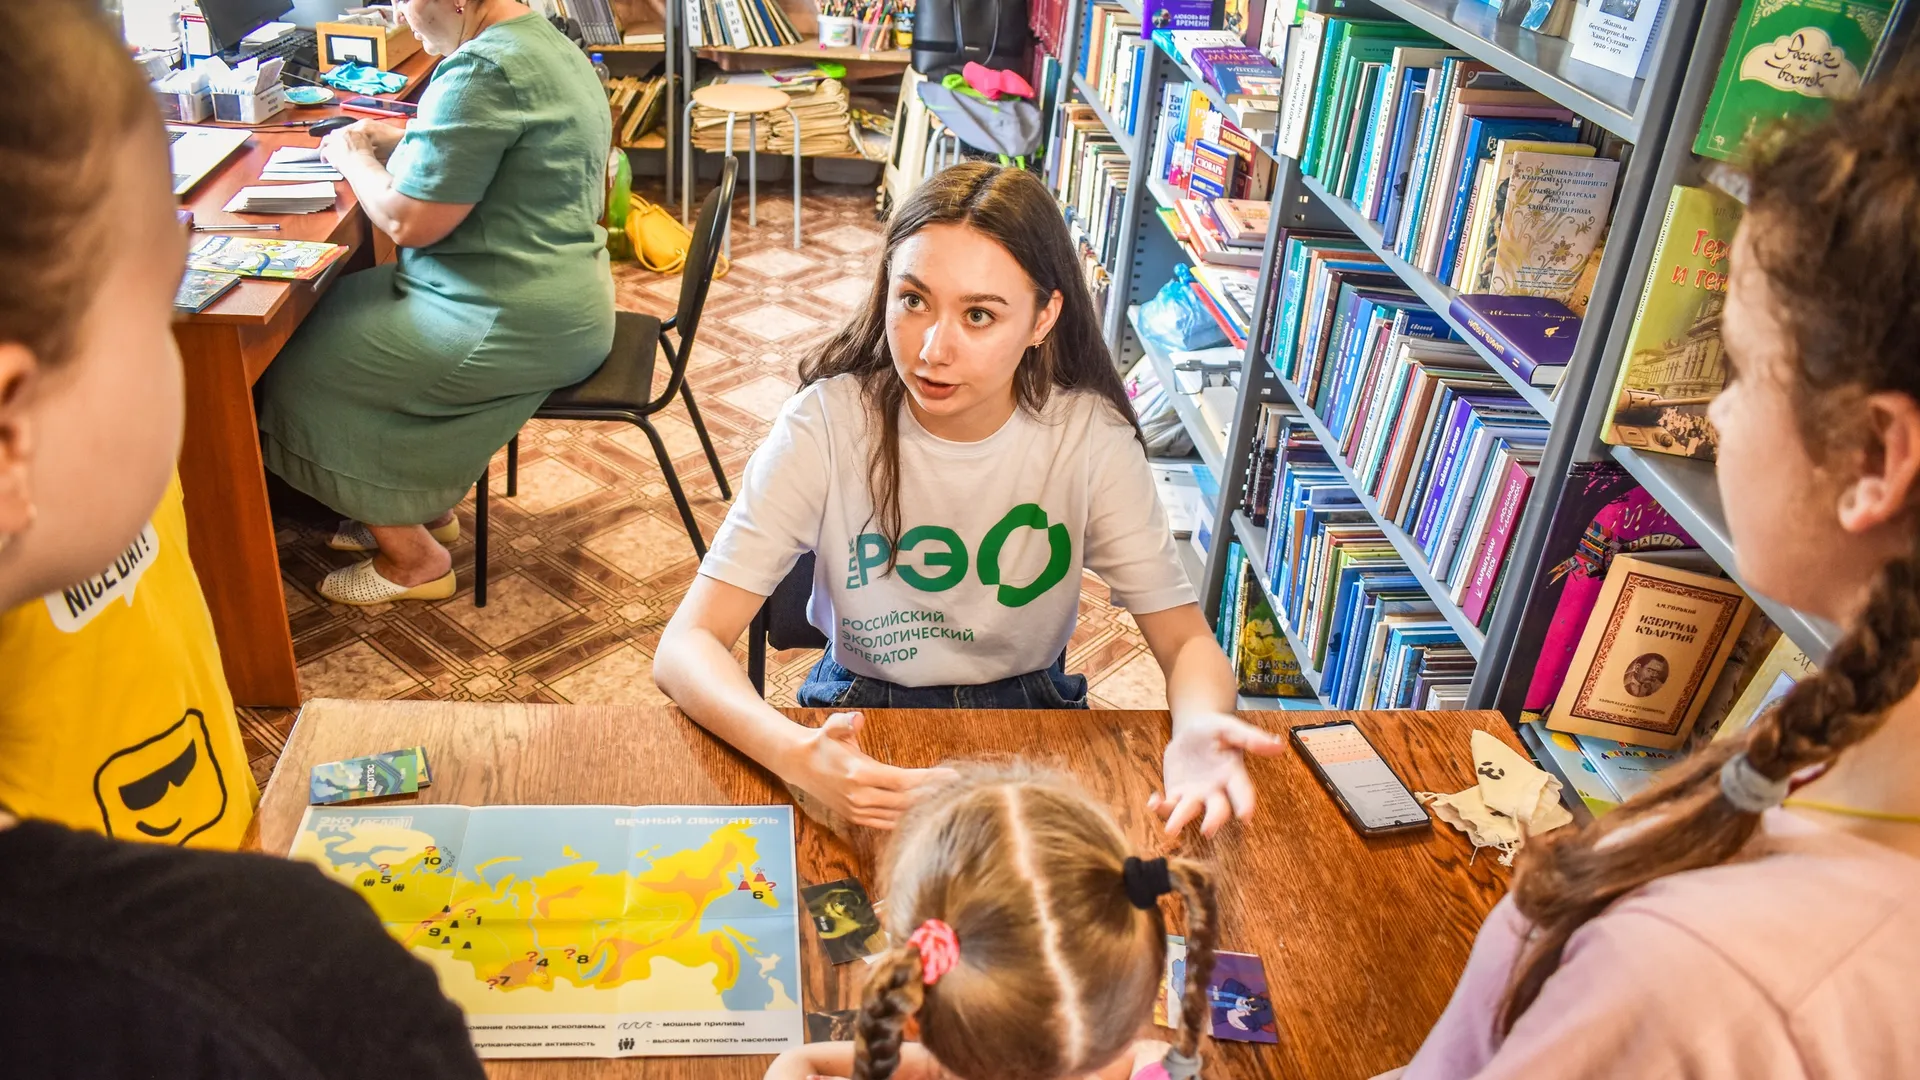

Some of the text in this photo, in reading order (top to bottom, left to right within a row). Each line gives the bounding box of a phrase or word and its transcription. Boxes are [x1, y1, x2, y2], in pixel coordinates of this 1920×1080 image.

[1175, 19, 1209, 27] ВРЕМЕНИ
[1589, 22, 1621, 37] бессмертие
[1603, 19, 1623, 29] Жизнь
[1592, 31, 1628, 48] Хана Султана
[1774, 33, 1840, 68] Россия
[1195, 156, 1223, 175] СЛОВАРЬ
[1528, 189, 1596, 199] КРЫМСКОТАТАРСКАЯ
[1671, 265, 1688, 286] и
[1321, 351, 1335, 387] ШАМИЛЬ
[856, 503, 1072, 607] РЭО
[62, 568, 117, 618] NICE
[842, 610, 944, 632] РОССИЙСКИЙ
[1640, 615, 1698, 634] ИЗЕРГИЛЬ
[842, 627, 974, 648] ЭКОЛОГИЧЕСКИЙ
[1635, 625, 1696, 644] КЪАРТИЙ
[843, 643, 918, 665] ОПЕРАТОР
[1258, 660, 1299, 669] ВАКЪЫ
[614, 815, 779, 827] ВЕЧНЫЙ ДВИГАТЕЛЬ
[424, 857, 442, 865] 10
[380, 875, 392, 883] 5
[752, 891, 764, 899] 6
[476, 917, 482, 925] 1
[428, 928, 441, 936] 9
[536, 958, 549, 967] 4
[576, 955, 589, 964] 8
[500, 976, 511, 985] 7
